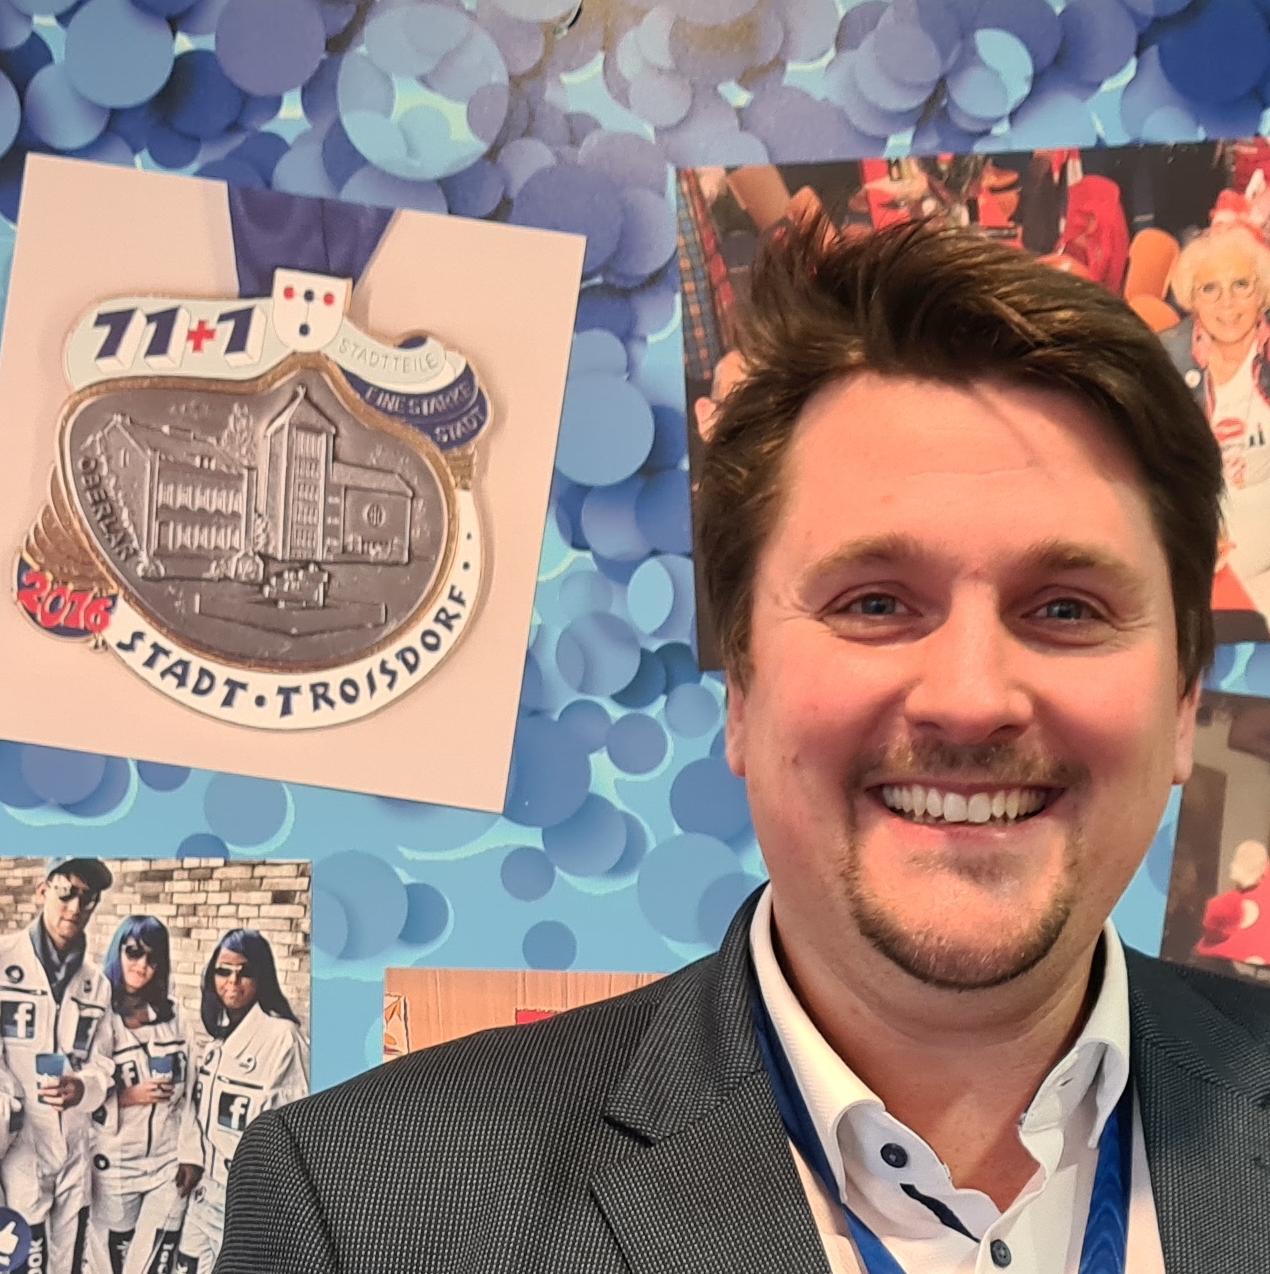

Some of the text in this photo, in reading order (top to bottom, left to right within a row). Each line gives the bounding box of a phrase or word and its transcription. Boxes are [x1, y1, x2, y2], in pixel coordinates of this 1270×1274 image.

[339, 337, 440, 374] STADTTEILE
[434, 405, 485, 442] STADT
[17, 571, 113, 634] 2016
[115, 584, 471, 719] STADT TROISDORF
